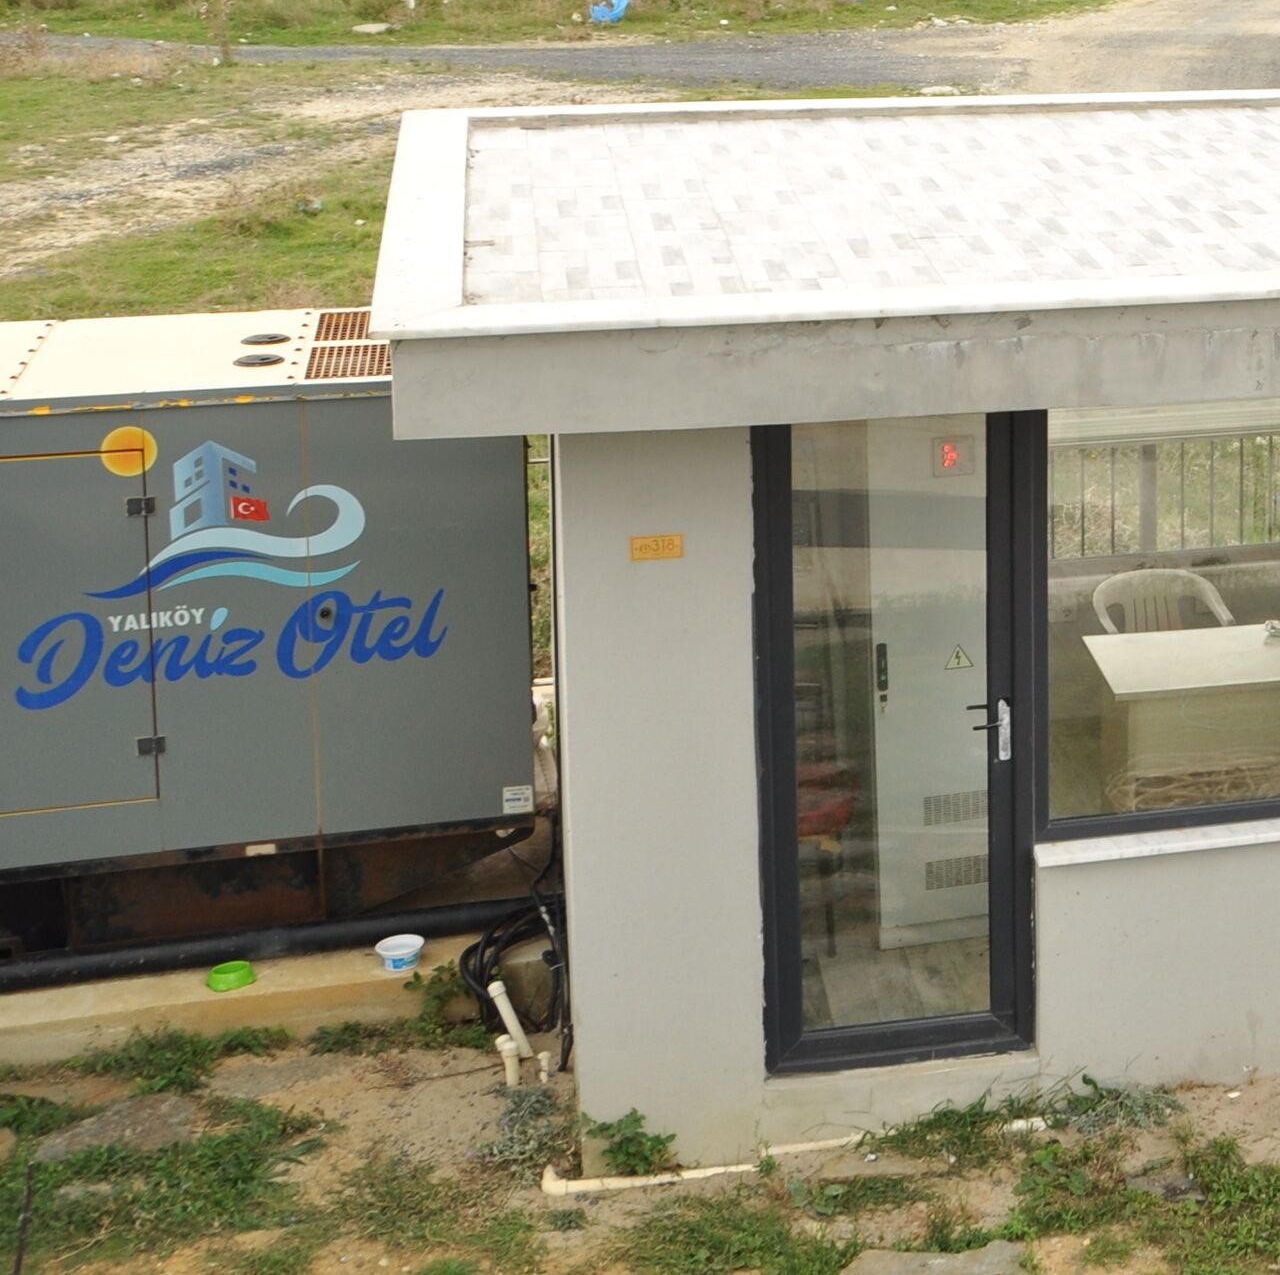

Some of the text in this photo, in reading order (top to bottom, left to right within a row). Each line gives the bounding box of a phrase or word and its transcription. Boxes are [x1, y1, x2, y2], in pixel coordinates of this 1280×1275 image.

[15, 588, 449, 710] Deniz Otel
[108, 605, 206, 633] YALIKÖY
